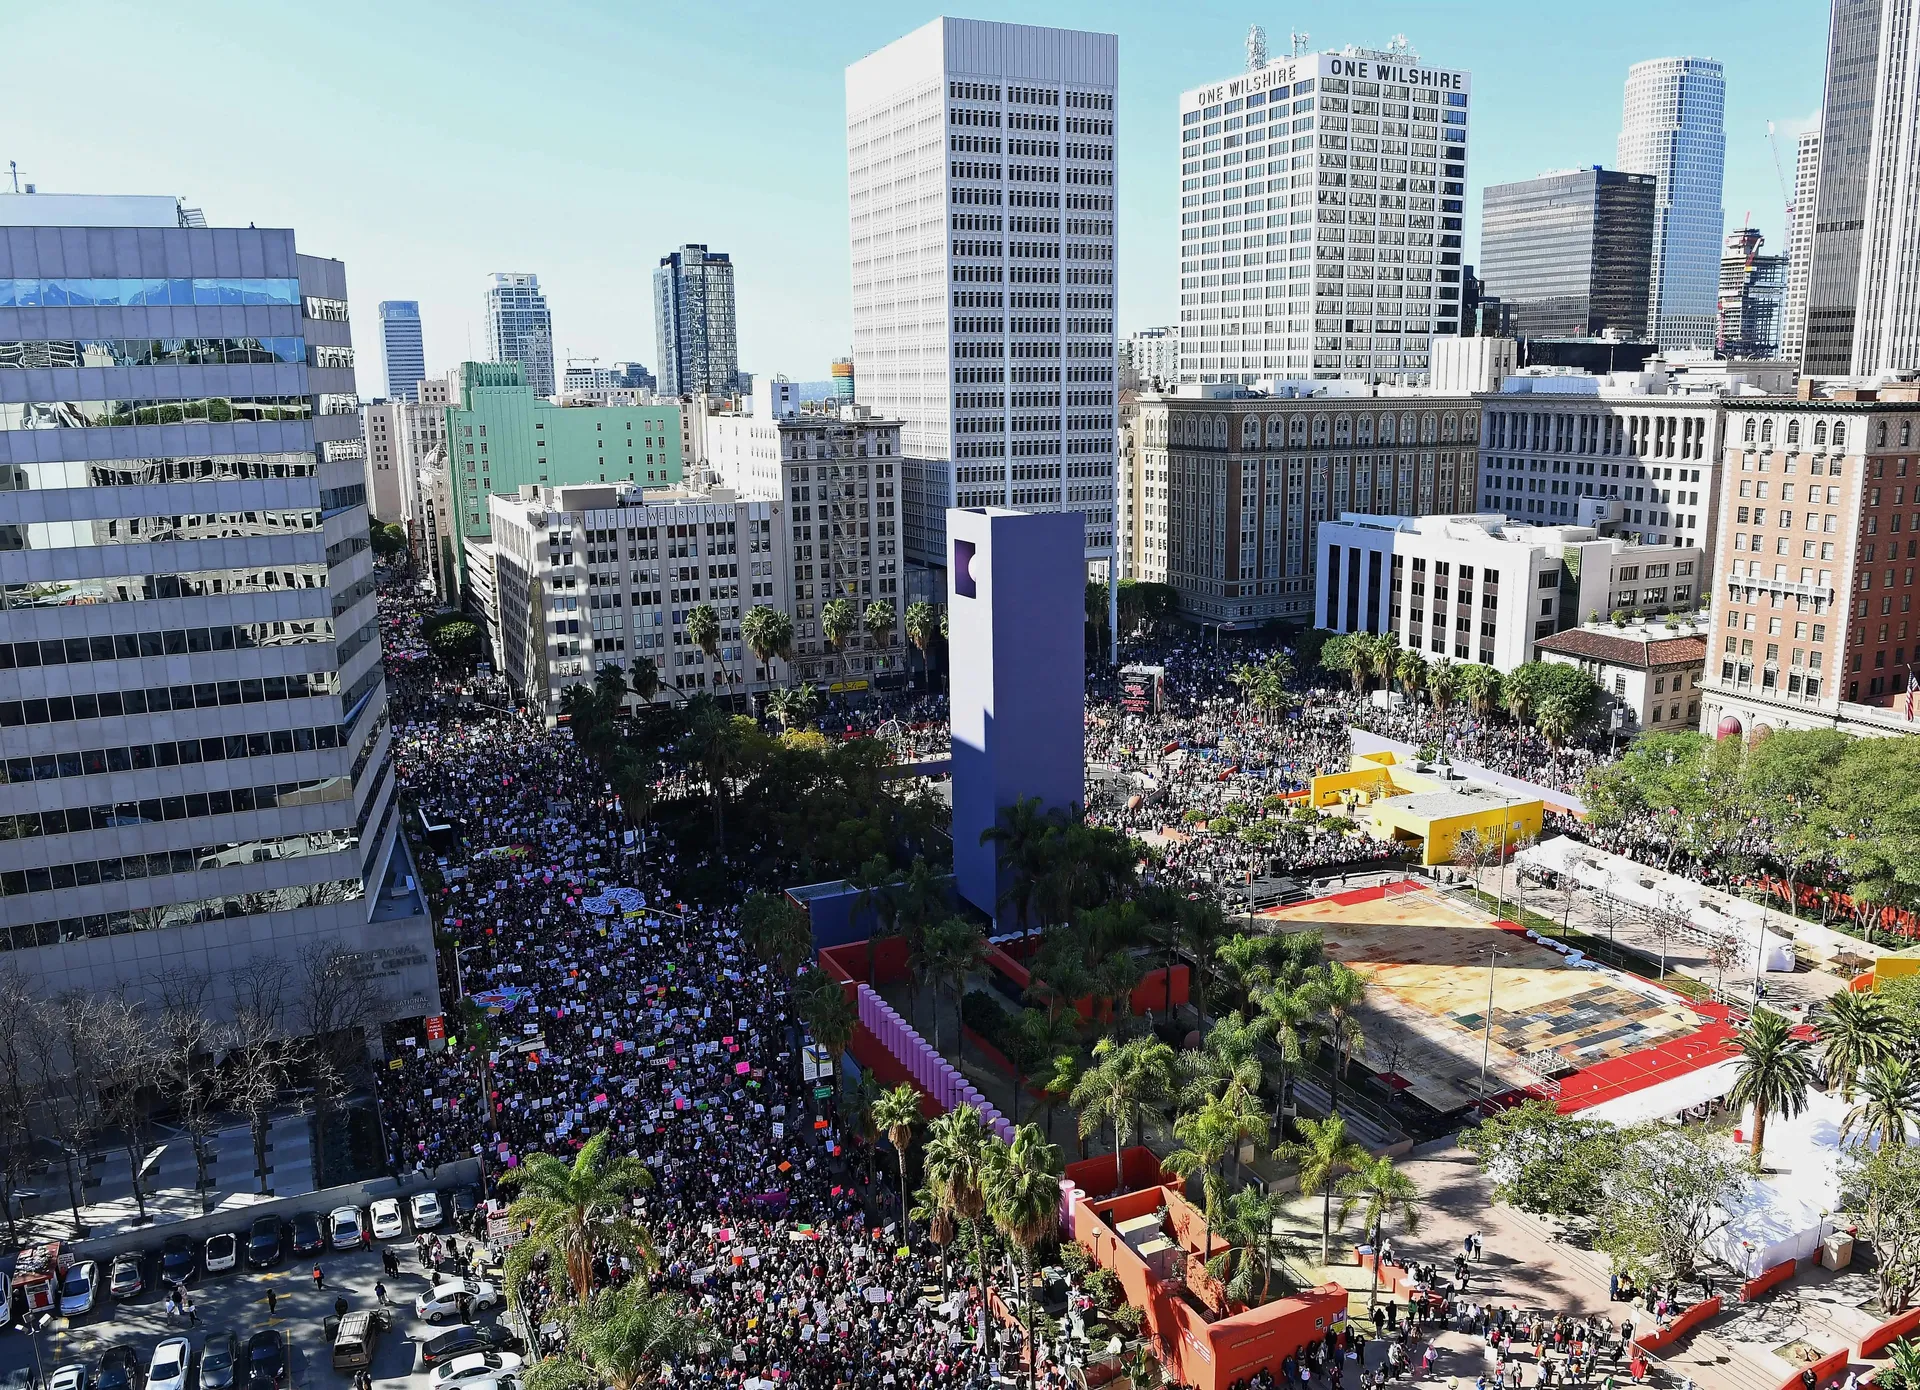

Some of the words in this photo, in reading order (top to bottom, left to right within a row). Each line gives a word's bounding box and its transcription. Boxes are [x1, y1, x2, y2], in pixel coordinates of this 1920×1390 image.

[1198, 86, 1224, 106] ONE
[1229, 64, 1297, 97] WILSHIRE
[1331, 59, 1368, 79] ONE
[1376, 64, 1462, 90] WILSHIRE
[628, 504, 697, 525] JEWELRY
[705, 506, 746, 518] MART
[651, 1057, 669, 1065] RESIST
